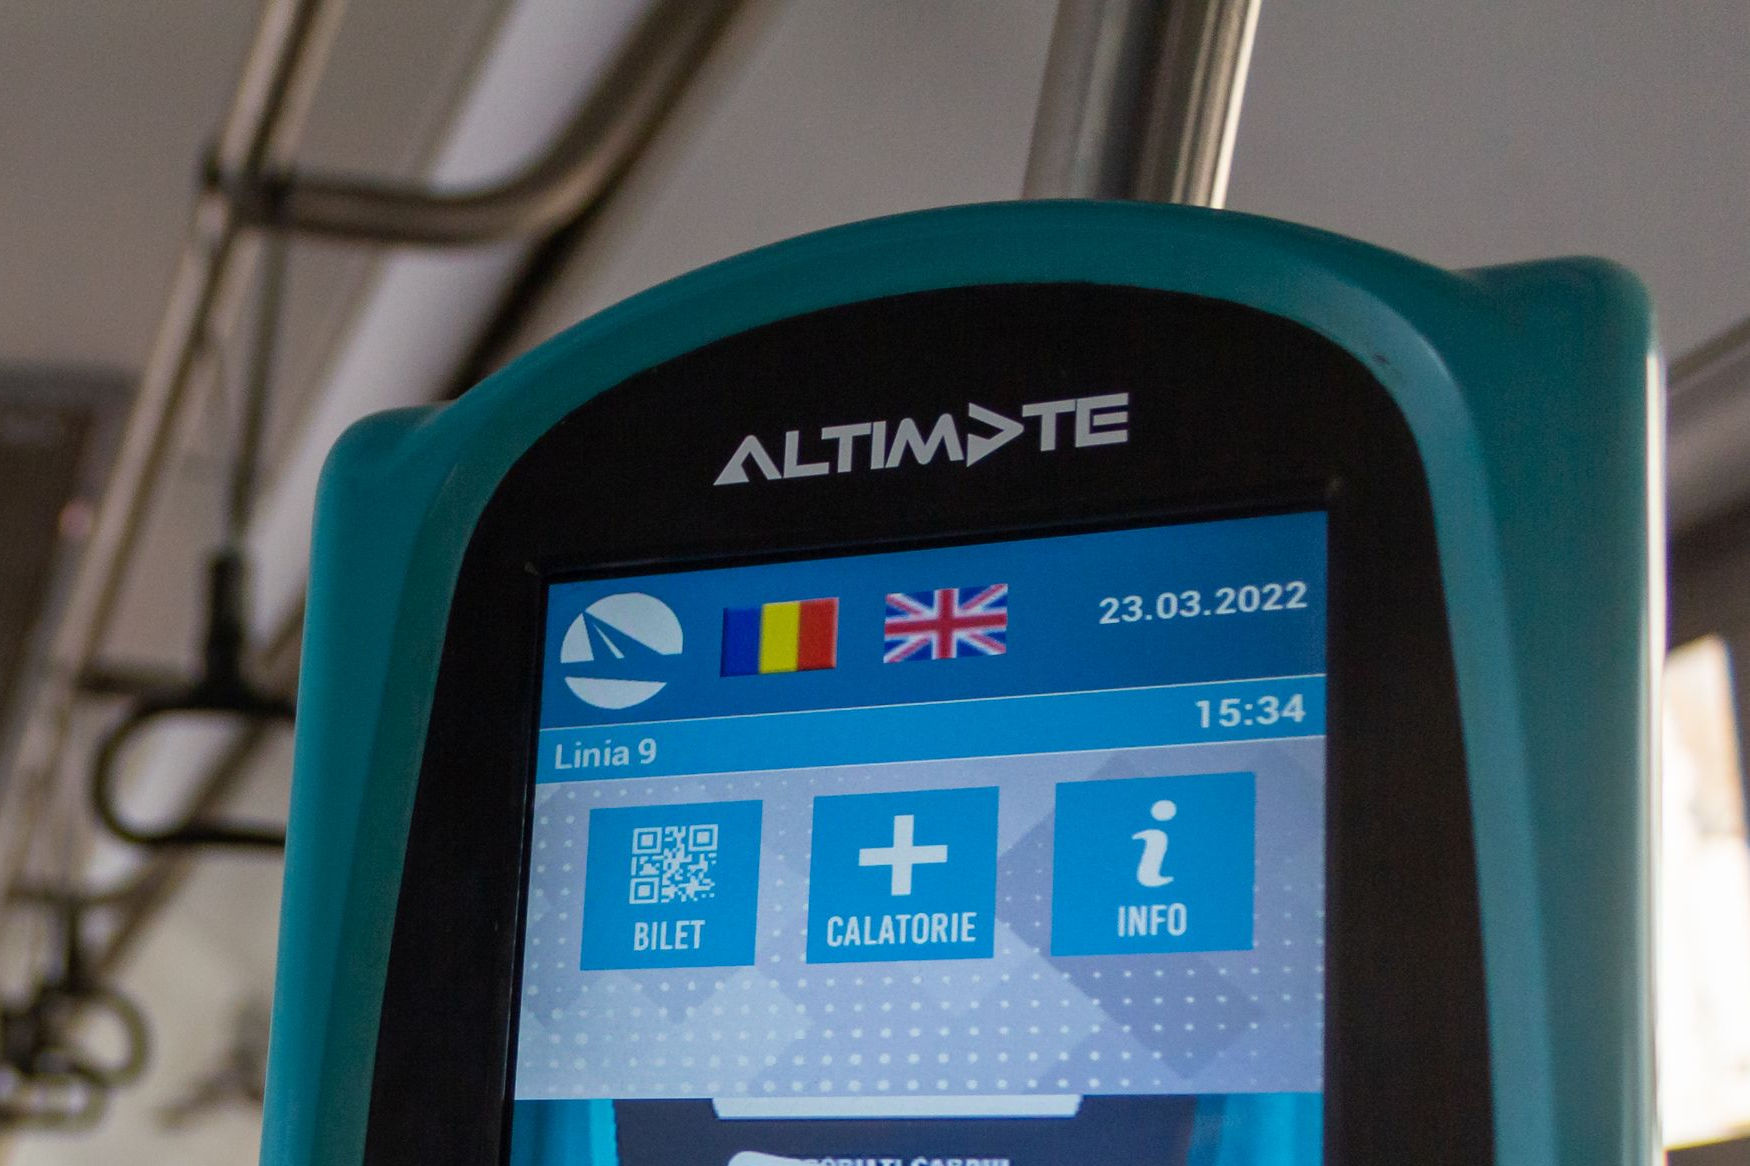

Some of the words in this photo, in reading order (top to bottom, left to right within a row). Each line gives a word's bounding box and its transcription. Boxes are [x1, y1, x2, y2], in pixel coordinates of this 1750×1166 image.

[714, 392, 1129, 486] ALTIMATE
[1099, 581, 1308, 626] 23.03.2022
[1195, 694, 1305, 729] 15:34
[554, 740, 631, 771] Linia
[638, 738, 657, 766] 9
[633, 920, 705, 950] BILET
[827, 911, 977, 949] CALATORIE
[1117, 903, 1187, 938] INFO
